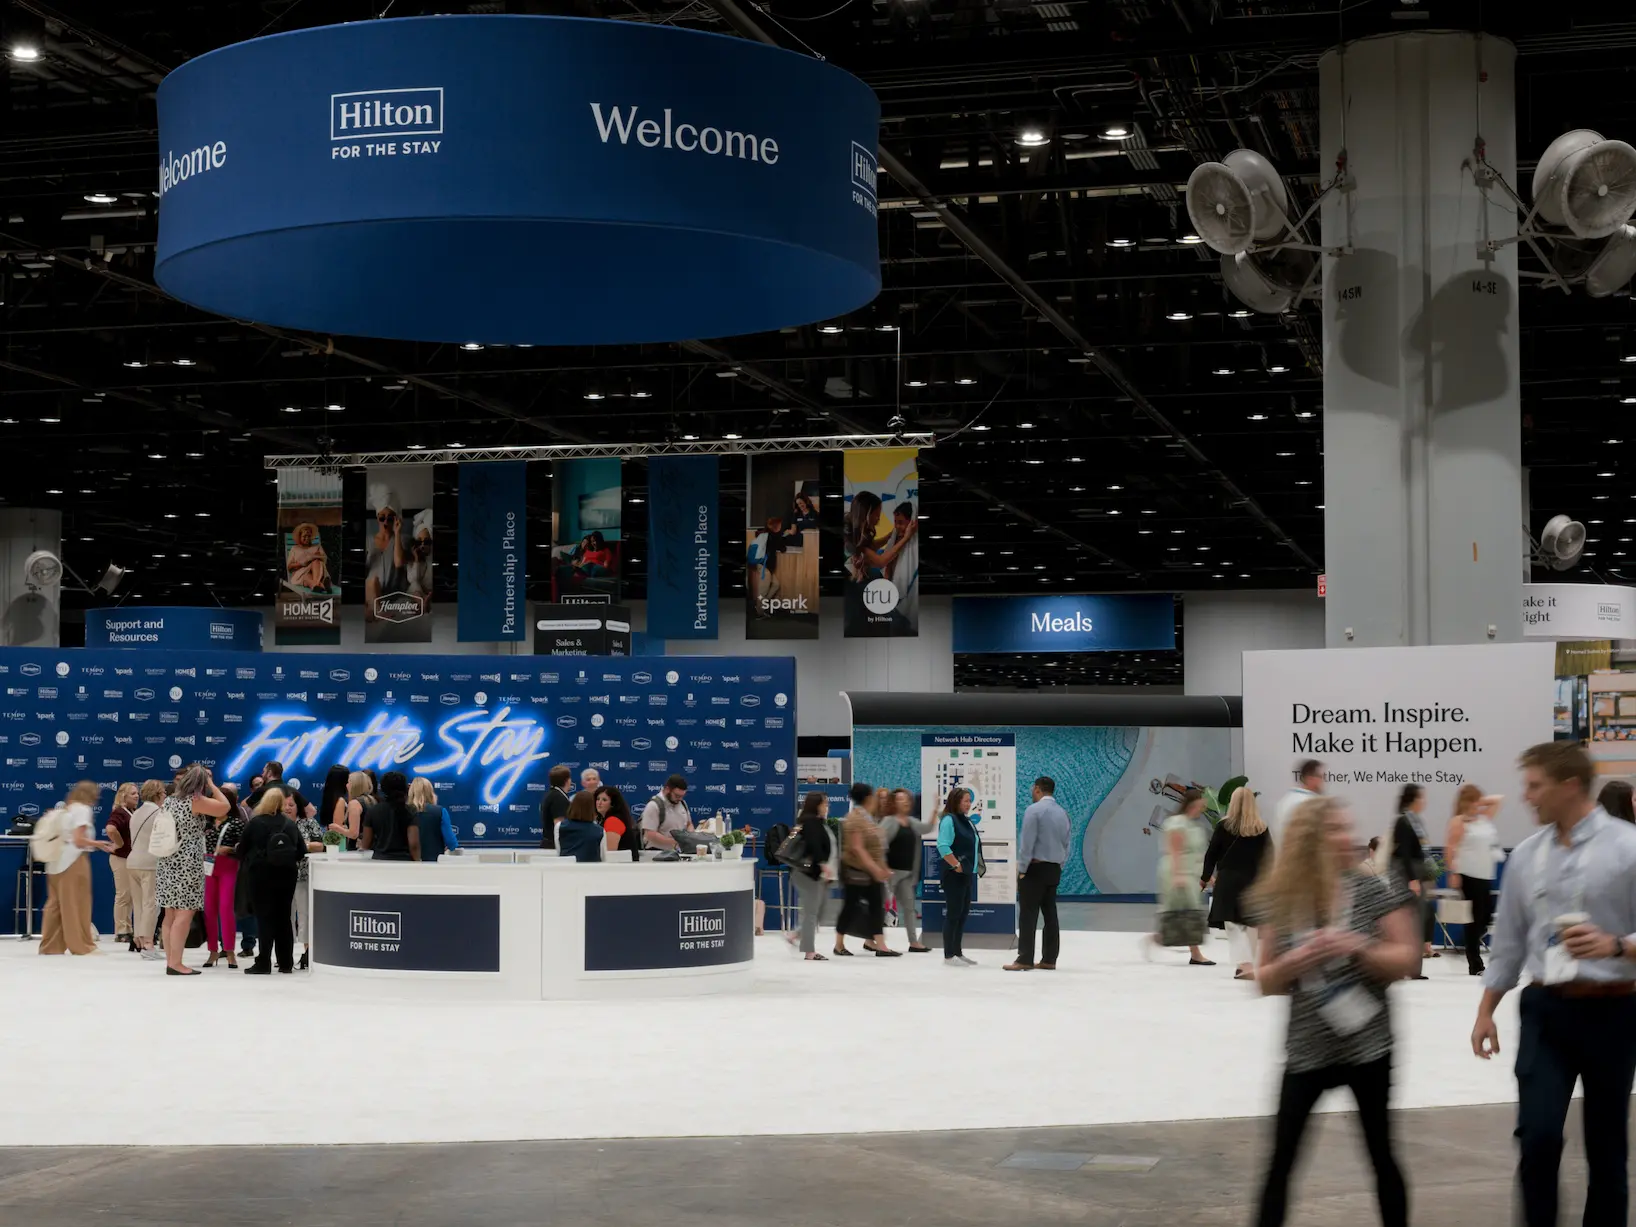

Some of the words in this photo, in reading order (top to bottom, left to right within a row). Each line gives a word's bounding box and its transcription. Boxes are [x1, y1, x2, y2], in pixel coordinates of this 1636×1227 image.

[339, 100, 434, 130] Hilton
[590, 102, 779, 165] Welcome
[331, 146, 360, 160] FOR
[365, 144, 396, 158] THE
[402, 140, 442, 155] STAY
[1338, 286, 1362, 302] 14SW
[1472, 280, 1497, 294] 14-SE
[502, 511, 516, 550] Place
[694, 504, 708, 544] Place
[502, 552, 518, 634] Partnership
[694, 548, 710, 630] Partnership
[864, 587, 892, 605] tru
[283, 597, 334, 624] HOME2
[377, 600, 420, 612] Hampton
[761, 594, 808, 614] spark
[1522, 596, 1545, 607] ake
[1548, 597, 1556, 607] it
[1599, 605, 1620, 614] Hilton
[106, 619, 141, 632] Support
[144, 618, 164, 629] and
[1031, 612, 1092, 633] Meals
[1524, 611, 1551, 624] ight
[110, 632, 158, 642] Resources
[556, 638, 575, 647] Sales
[1292, 703, 1376, 724] Dream.
[1384, 702, 1470, 729] Inspire.
[1292, 732, 1354, 753] Make
[1362, 732, 1378, 753] it
[1386, 732, 1482, 758] Happen.
[228, 714, 343, 779] For
[340, 711, 424, 770] the
[413, 706, 550, 804] Stay
[1354, 771, 1373, 782] We
[1376, 770, 1408, 782] Make
[1411, 770, 1432, 782] the
[1435, 770, 1465, 785] Stay.
[353, 915, 397, 935] Hilton
[683, 914, 722, 932] Hilton
[350, 942, 362, 950] FOR
[381, 943, 400, 952] STAY
[710, 940, 725, 948] STAY
